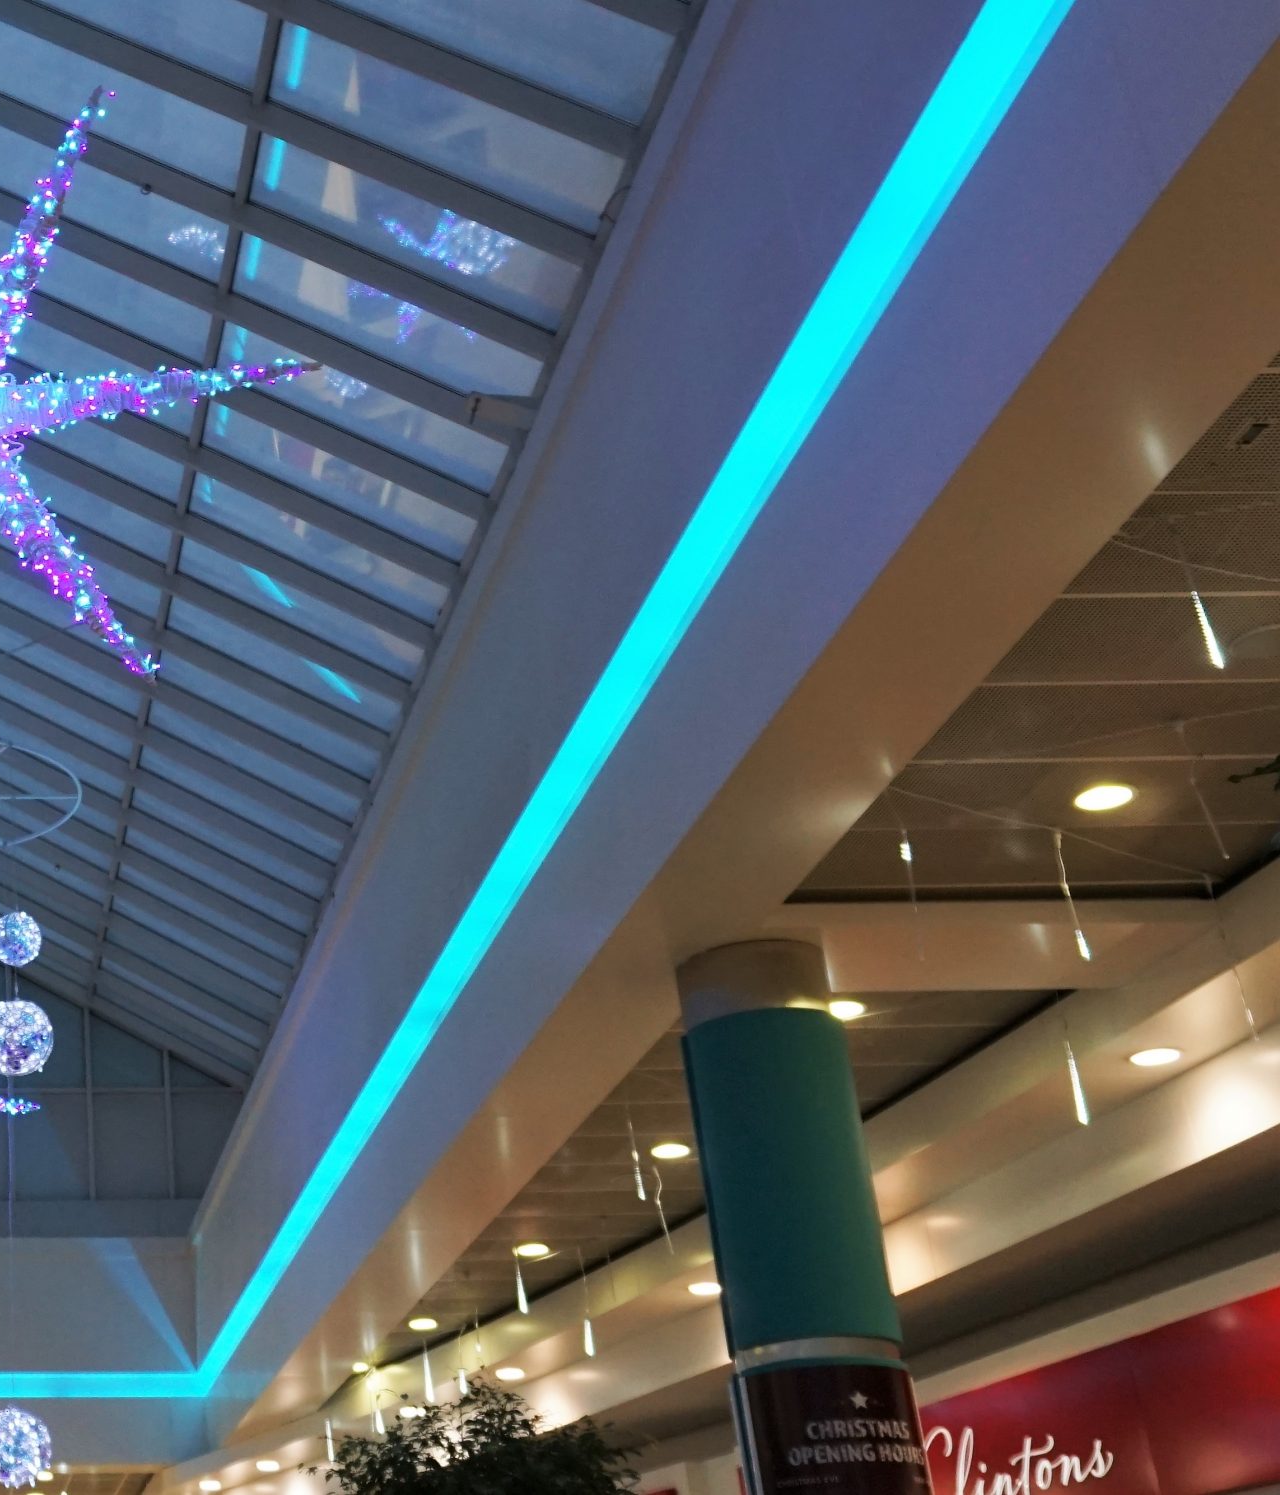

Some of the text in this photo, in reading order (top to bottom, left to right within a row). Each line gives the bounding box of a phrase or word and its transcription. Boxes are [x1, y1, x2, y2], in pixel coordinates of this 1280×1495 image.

[806, 1419, 910, 1440] CHRISTMAS
[788, 1443, 925, 1466] OPENING HOURS
